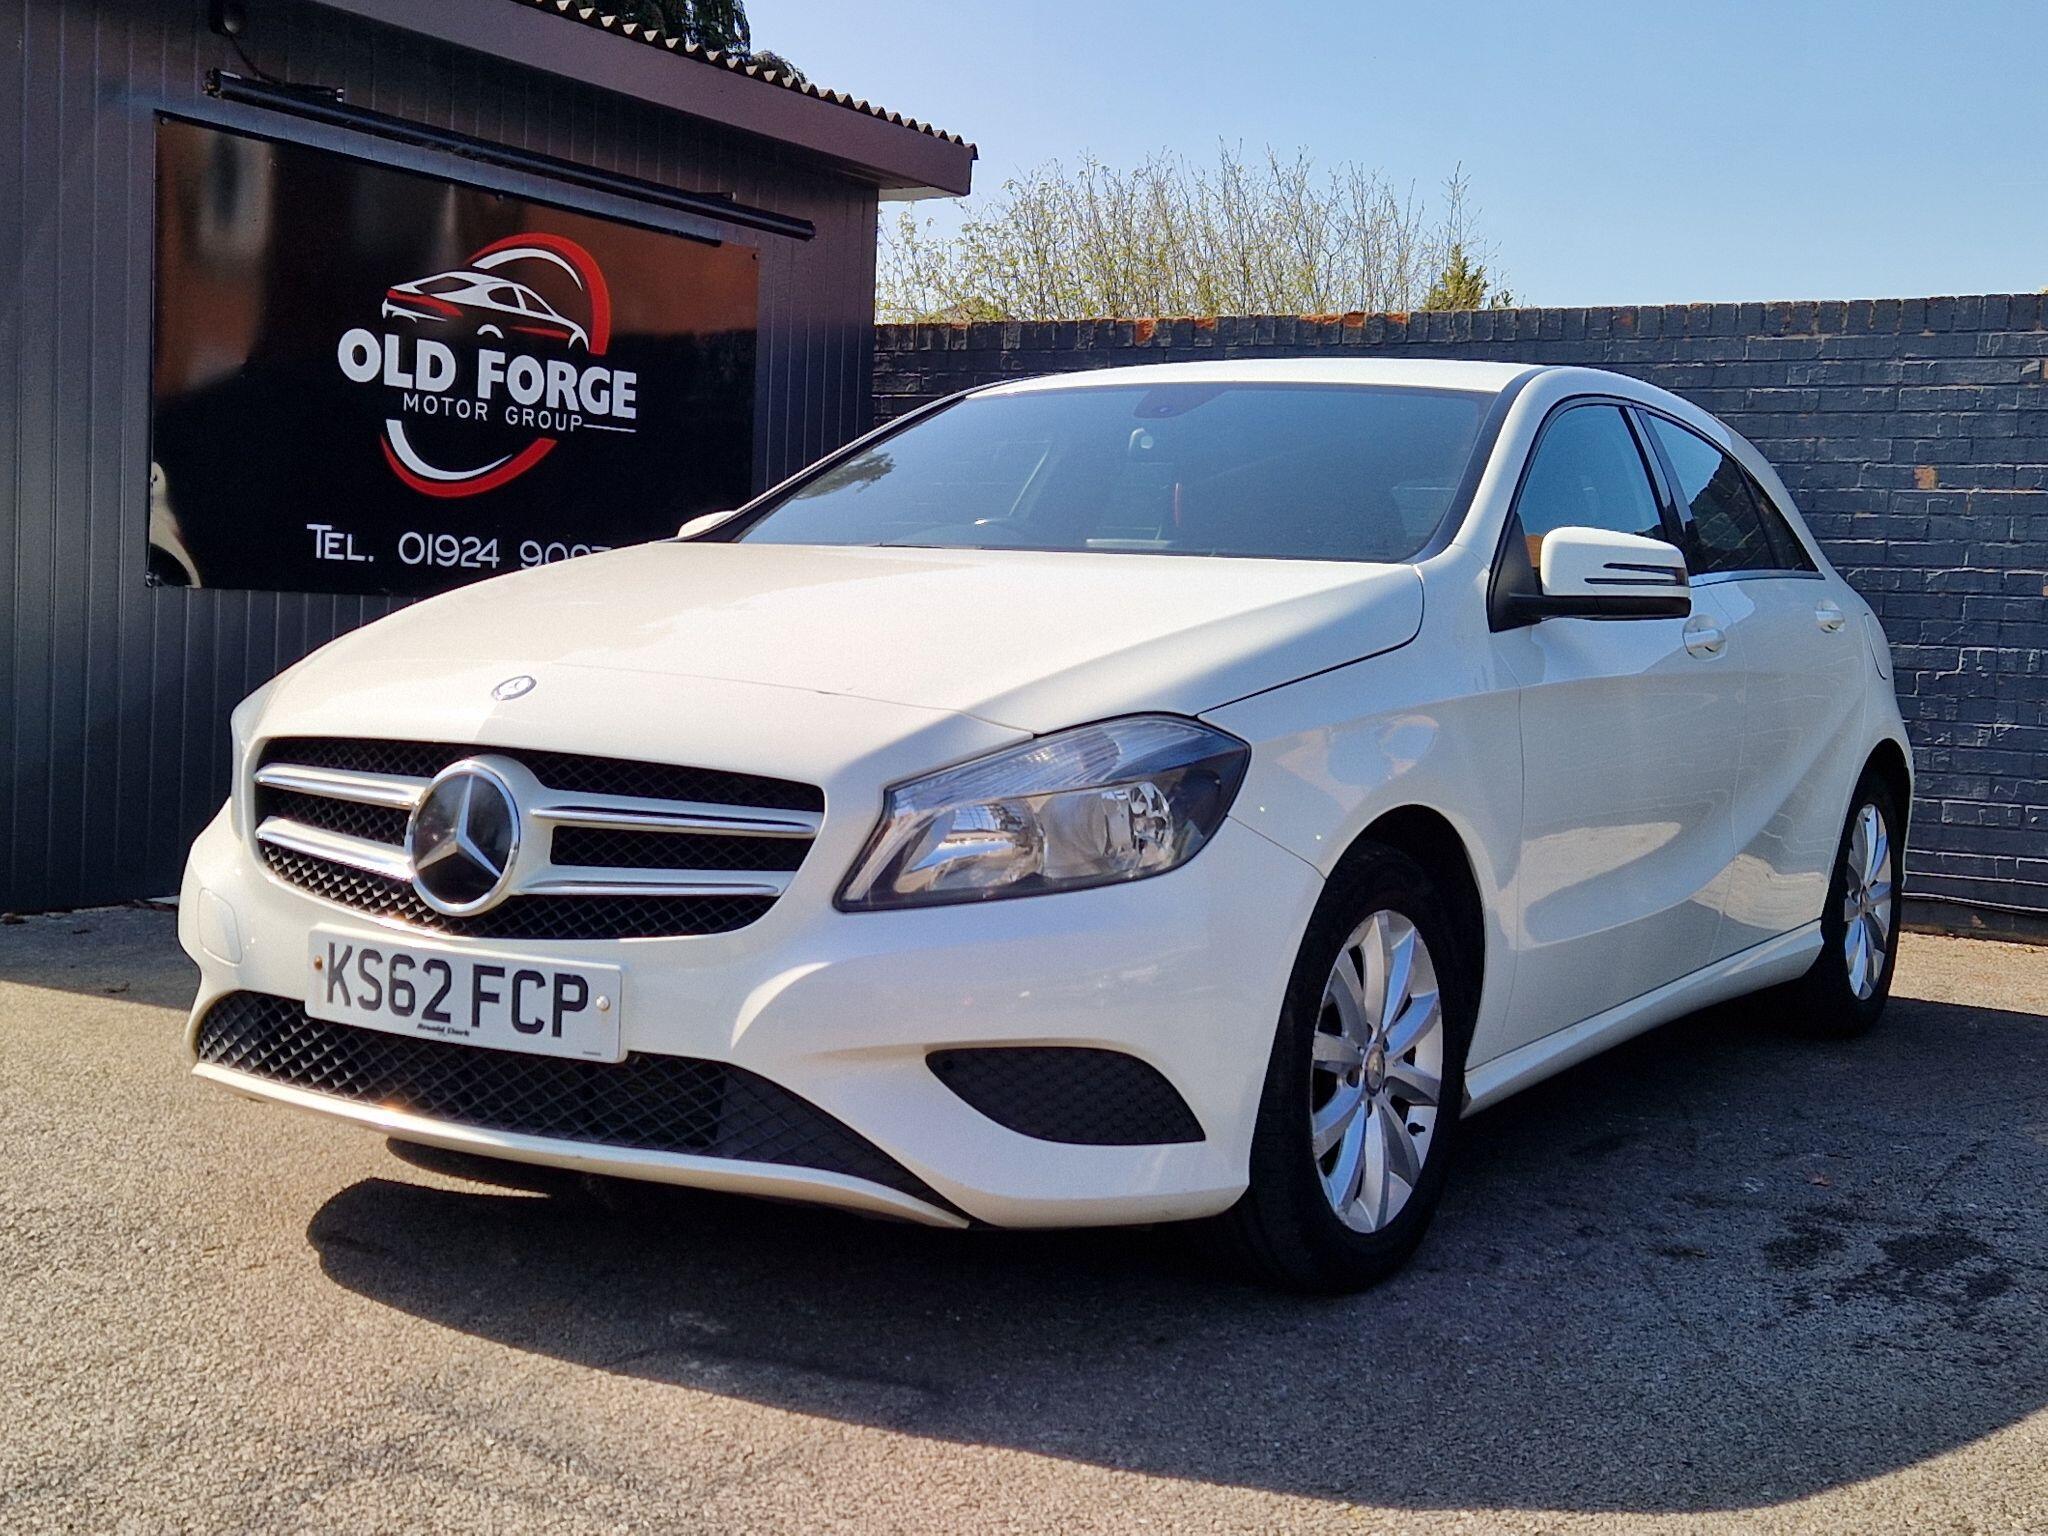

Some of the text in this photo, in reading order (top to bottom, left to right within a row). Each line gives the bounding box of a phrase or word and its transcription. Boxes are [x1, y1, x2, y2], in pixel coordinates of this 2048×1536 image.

[337, 328, 637, 420] OLD FORGE
[403, 392, 583, 432] MOTOR GROUP
[398, 531, 501, 569] 01924
[327, 942, 589, 1038] KS62 FCP
